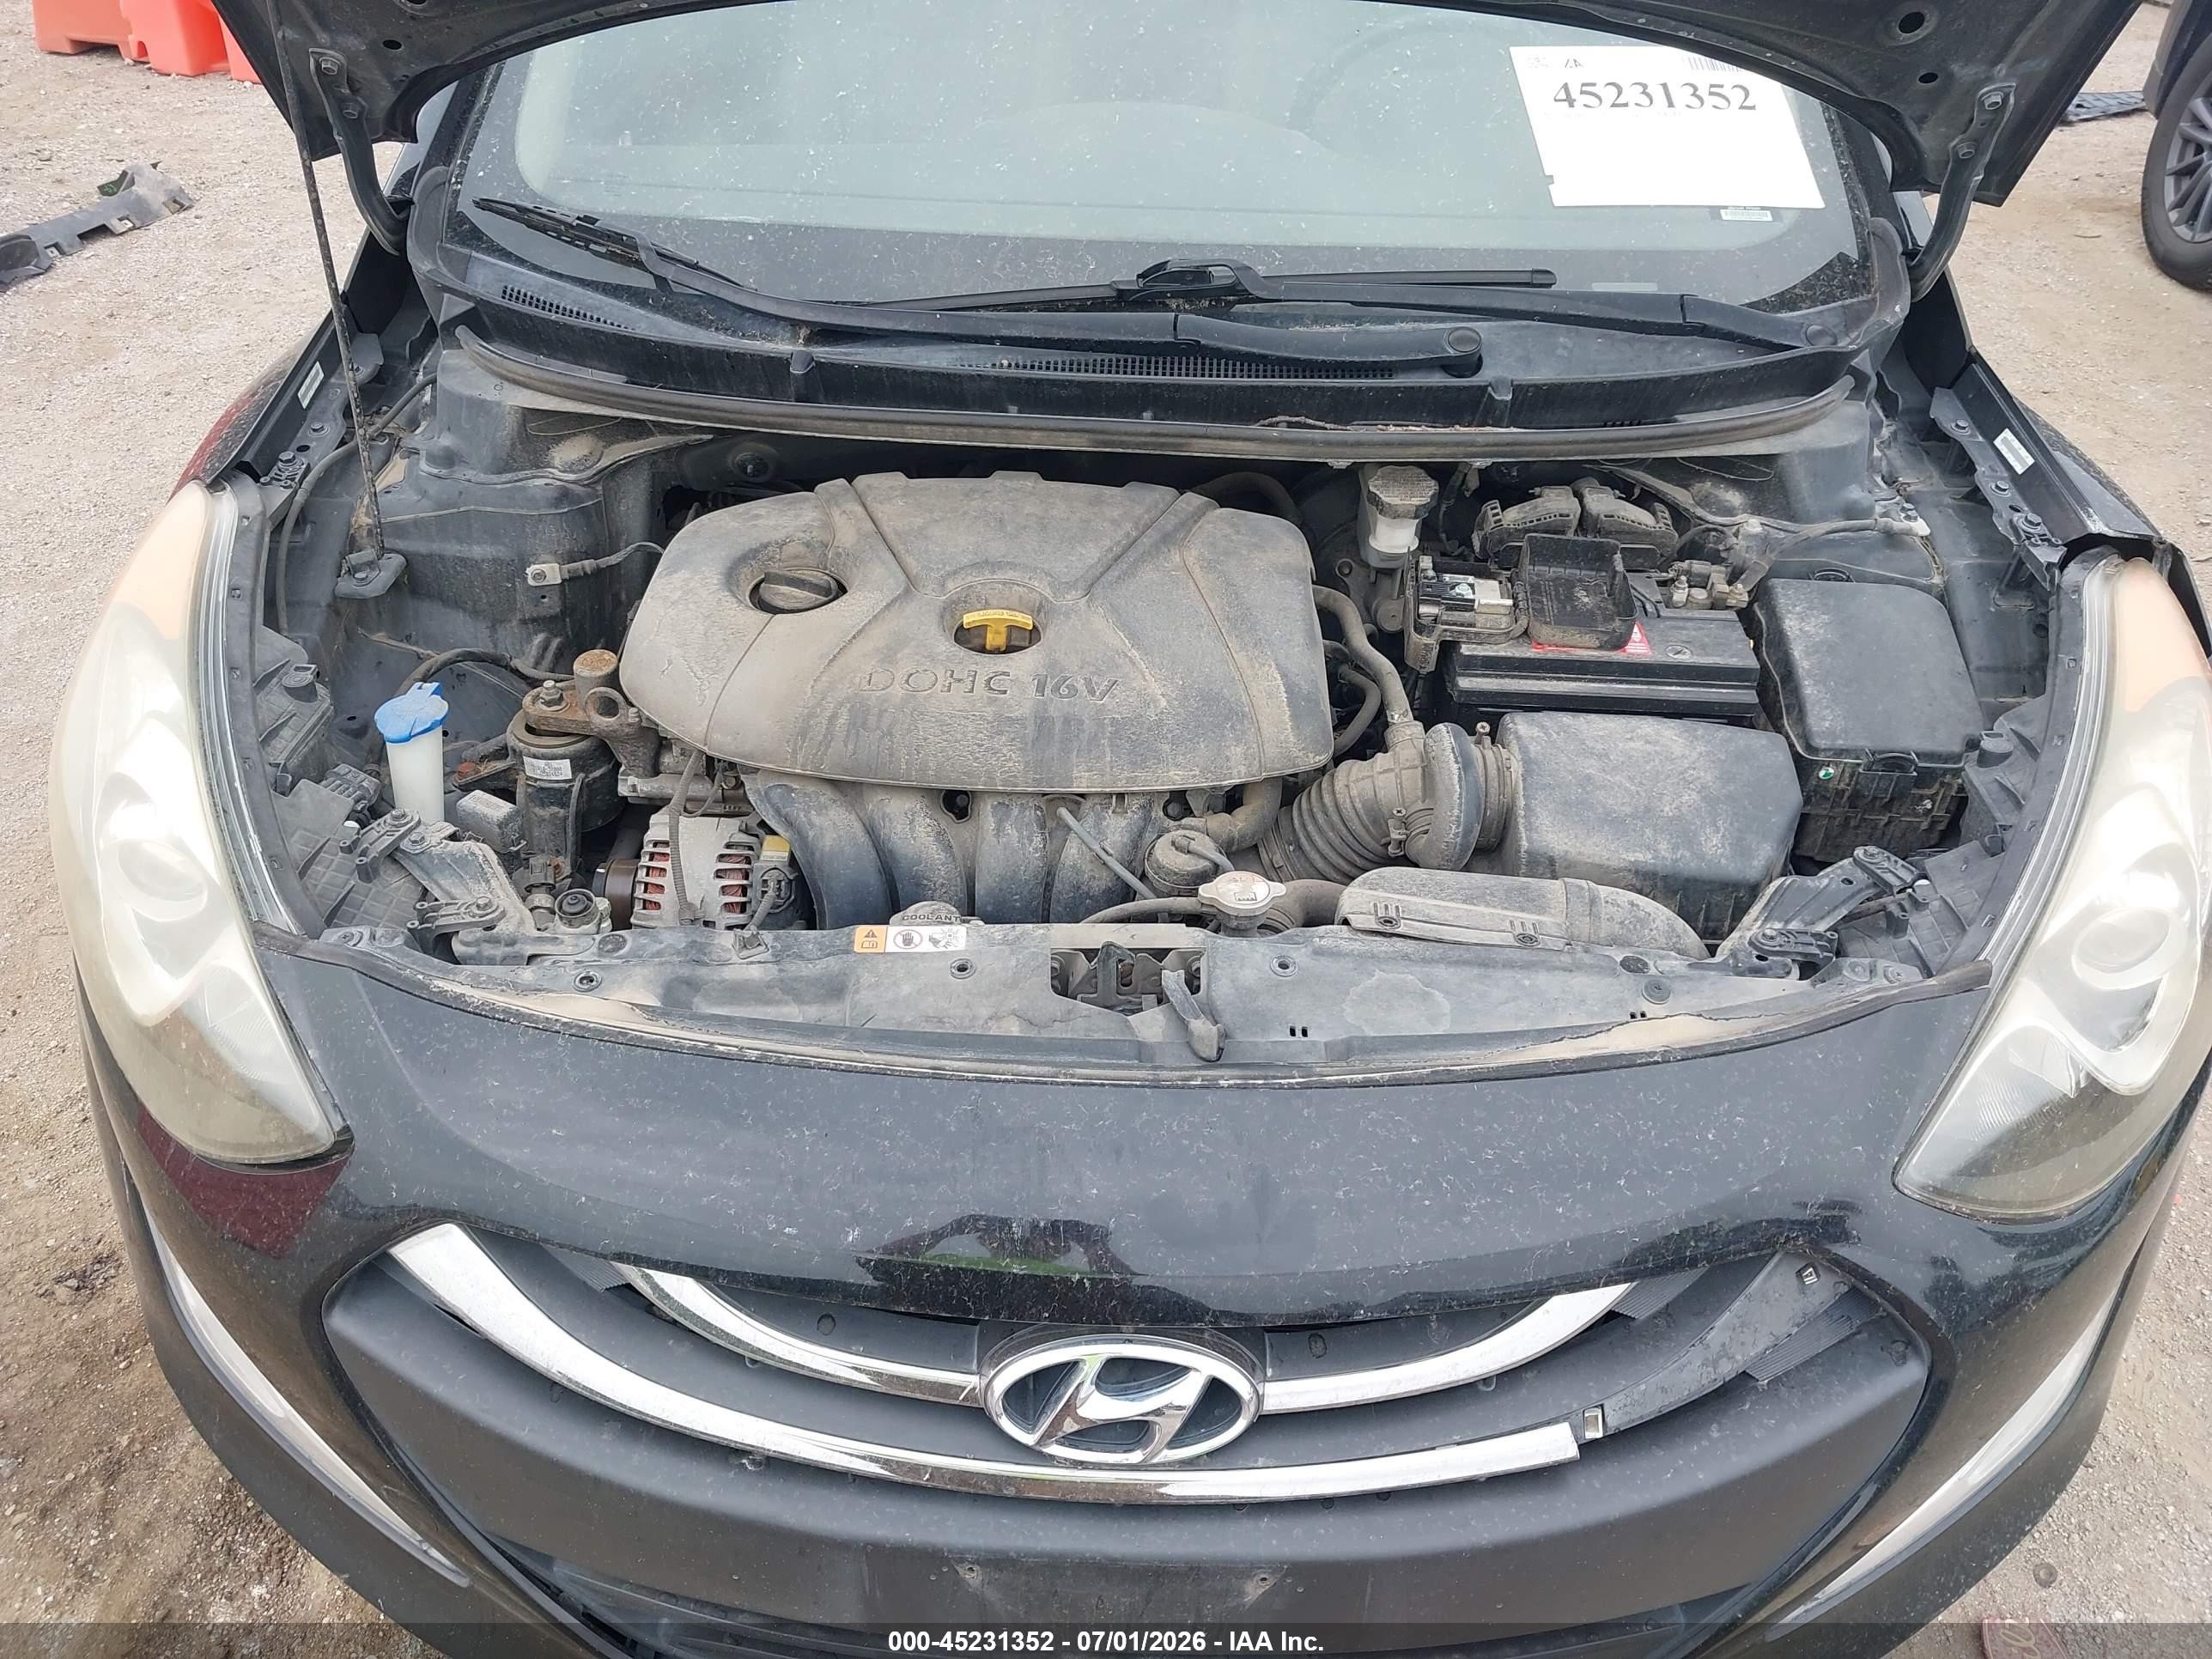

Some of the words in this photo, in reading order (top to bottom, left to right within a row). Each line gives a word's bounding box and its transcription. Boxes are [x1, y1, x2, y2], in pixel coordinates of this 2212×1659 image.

[1553, 82, 1757, 110] 45231352
[860, 669, 1011, 695] DOHC
[1030, 672, 1119, 702] 16V
[902, 913, 961, 923] COOLANT
